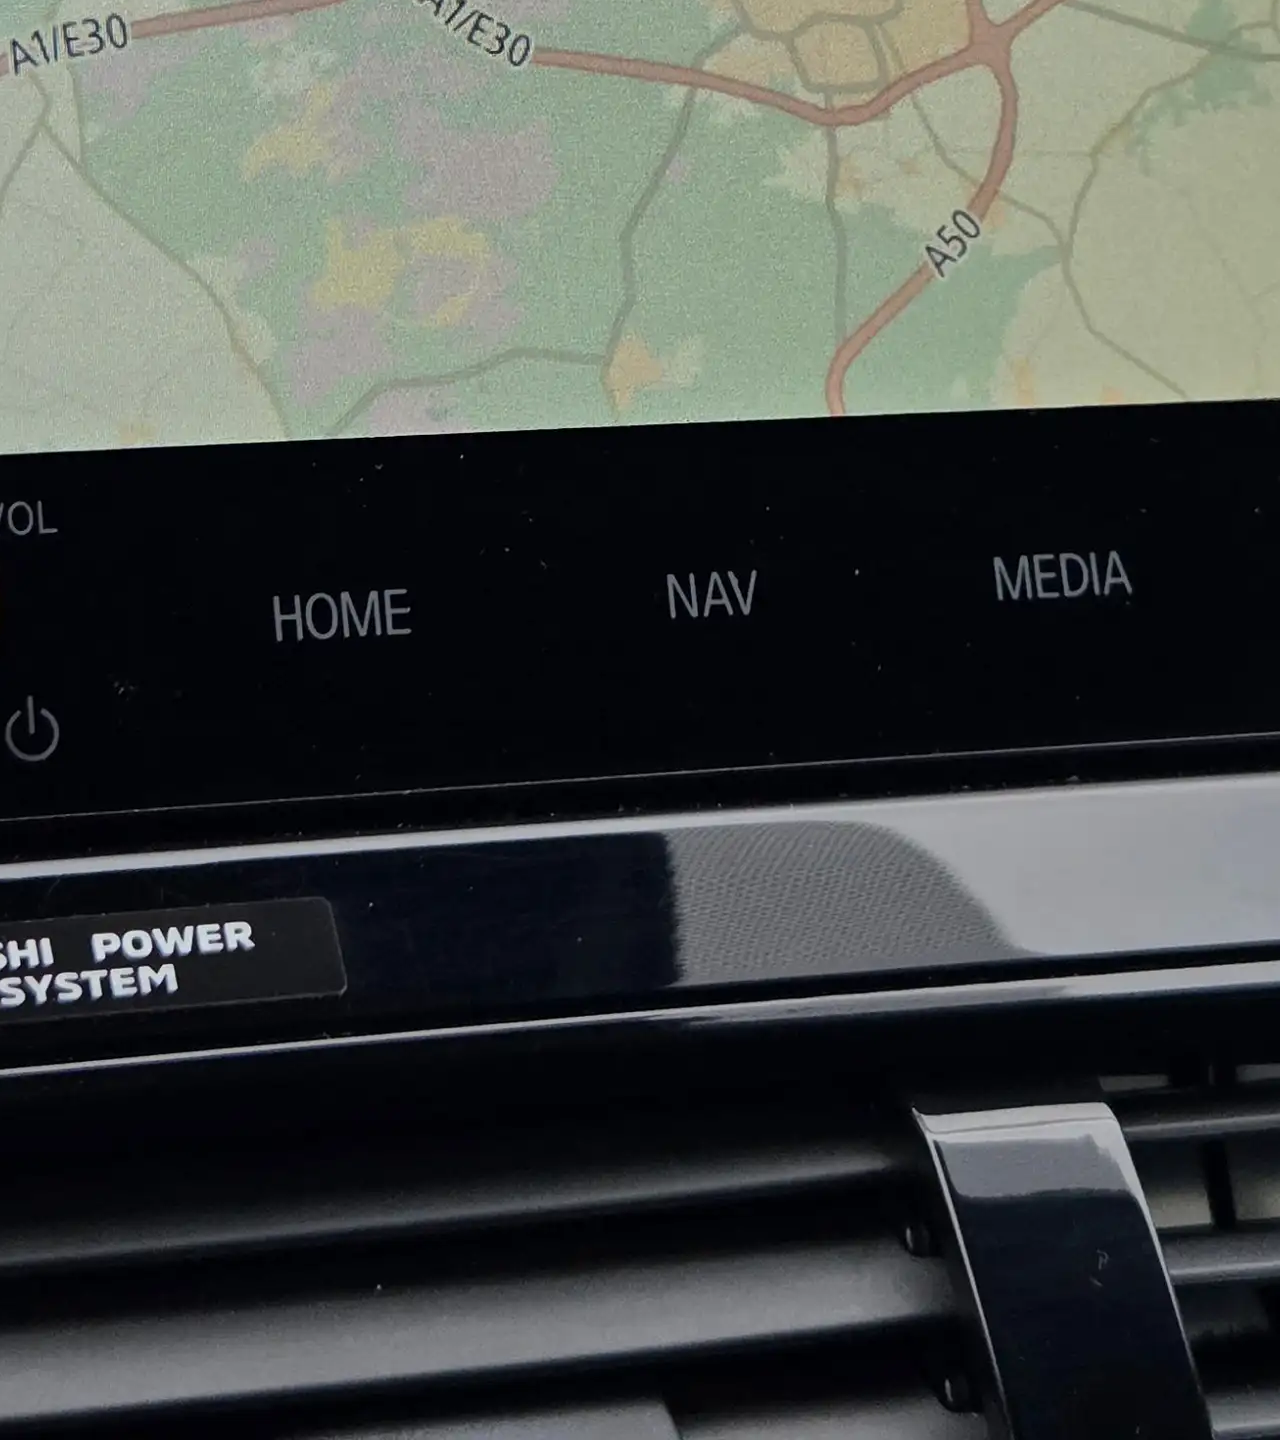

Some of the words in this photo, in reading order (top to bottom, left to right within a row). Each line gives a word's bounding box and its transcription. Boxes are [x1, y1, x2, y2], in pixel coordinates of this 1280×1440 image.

[9, 13, 130, 74] A1/E30
[925, 208, 982, 277] A50
[666, 570, 758, 620] NAV
[993, 551, 1133, 601] MEDIA
[271, 588, 412, 642] HOME
[91, 921, 256, 962] POWER
